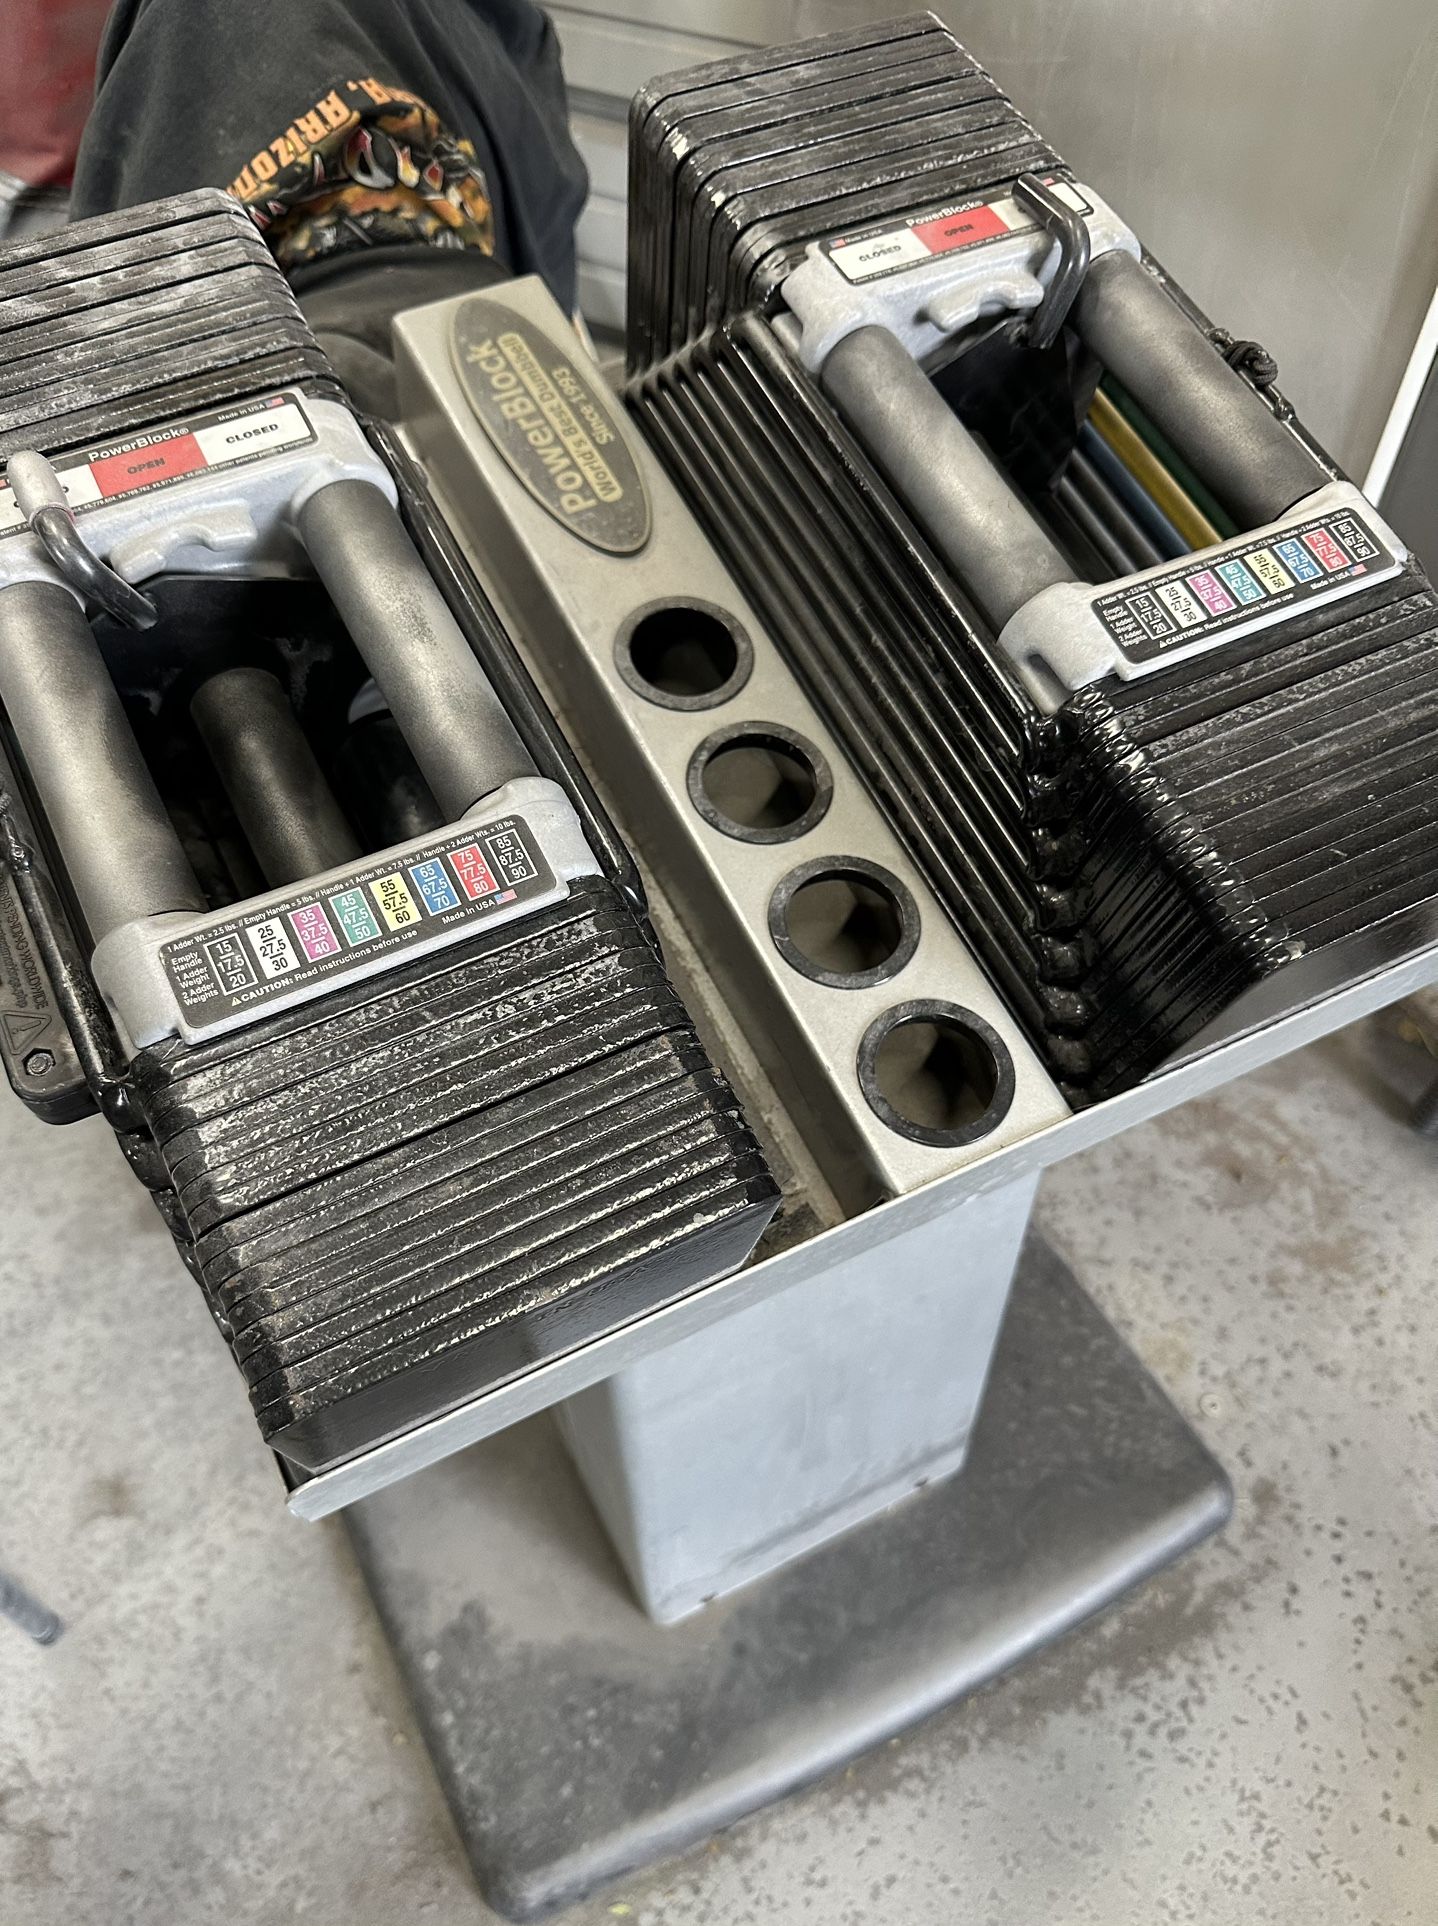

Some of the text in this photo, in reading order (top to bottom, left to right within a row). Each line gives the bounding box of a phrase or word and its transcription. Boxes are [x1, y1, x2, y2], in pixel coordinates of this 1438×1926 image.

[227, 90, 351, 201] ARIZON
[944, 224, 974, 237] OPEN
[859, 245, 902, 262] CLOSED
[217, 412, 239, 422] Made
[249, 403, 265, 413] USA
[552, 366, 616, 445] Since 1993
[502, 334, 618, 498] World's Best Dumbbell
[226, 423, 279, 444] CLOSED
[466, 338, 598, 514] PowerBlock
[127, 457, 166, 475] OPEN
[1338, 523, 1351, 534] 85
[1310, 532, 1324, 543] 75
[1344, 533, 1365, 546] 87.5
[1281, 544, 1295, 554] 65
[1316, 543, 1337, 557] 77.5
[1357, 546, 1370, 557] 90
[1253, 554, 1267, 564] 55
[1288, 553, 1309, 567] 67.5
[1329, 557, 1343, 567] 80
[1225, 564, 1239, 575] 45
[1259, 565, 1279, 578] 57.5
[1301, 567, 1315, 578] 70
[1195, 575, 1208, 586] 35
[1272, 578, 1285, 588] 60
[1310, 579, 1328, 589] Made
[1335, 571, 1351, 580] USA
[1165, 586, 1179, 598] 25
[1201, 586, 1222, 600] 37.5
[1242, 589, 1257, 600] 50
[1103, 605, 1124, 617] Empty
[1135, 598, 1149, 609] 15
[1171, 597, 1192, 611] 27.5
[1214, 601, 1227, 611] 40
[1105, 610, 1128, 622] Handle
[1115, 616, 1134, 628] Adder
[1141, 608, 1162, 623] 17.5
[1166, 593, 1294, 645] CAUTION: Read instructions before use
[1184, 611, 1197, 622] 30
[1114, 623, 1138, 635] Weight
[1124, 629, 1142, 640] Adder
[1153, 623, 1167, 634] 20
[1121, 635, 1148, 648] Weights
[496, 835, 512, 850] 85
[457, 849, 474, 864] 75
[499, 848, 524, 866] 87.5
[419, 864, 436, 879] 65
[460, 863, 487, 881] 77.5
[511, 865, 527, 880] 90
[173, 939, 195, 951] Adder
[195, 934, 208, 944] Wt.
[213, 927, 225, 937] 2.5
[225, 923, 239, 933] lbs.
[245, 913, 266, 925] Empty
[266, 902, 291, 916] Handle
[302, 894, 316, 903] lbs.
[320, 882, 344, 897] Handle
[356, 872, 375, 883] Adder
[375, 867, 388, 876] Wt.
[392, 862, 403, 870] 7.5
[423, 846, 445, 858] Handle
[456, 835, 475, 846] Adder
[475, 830, 490, 841] Wts.
[504, 820, 516, 828] lbs.
[380, 878, 396, 894] 55
[422, 878, 448, 896] 67.5
[473, 880, 489, 895] 80
[341, 893, 357, 908] 45
[382, 892, 409, 911] 57.5
[433, 895, 450, 910] 70
[299, 909, 316, 923] 35
[343, 907, 369, 926] 47.5
[395, 910, 411, 924] 60
[442, 898, 496, 924] Made in USA
[258, 924, 274, 940] 25
[301, 922, 328, 941] 37.5
[355, 925, 371, 940] 50
[216, 940, 233, 955] 15
[260, 938, 287, 958] 27.5
[314, 940, 330, 955] 40
[171, 951, 199, 966] Empty
[173, 957, 203, 974] Handle
[217, 954, 245, 973] 17.5
[241, 929, 418, 1002] CAUTION: Read instructions before use
[272, 957, 289, 972] 30
[183, 965, 208, 981] Adder
[180, 973, 210, 989] Weight
[229, 973, 247, 989] 20
[190, 981, 215, 997] Adder
[183, 988, 219, 1006] Weights
